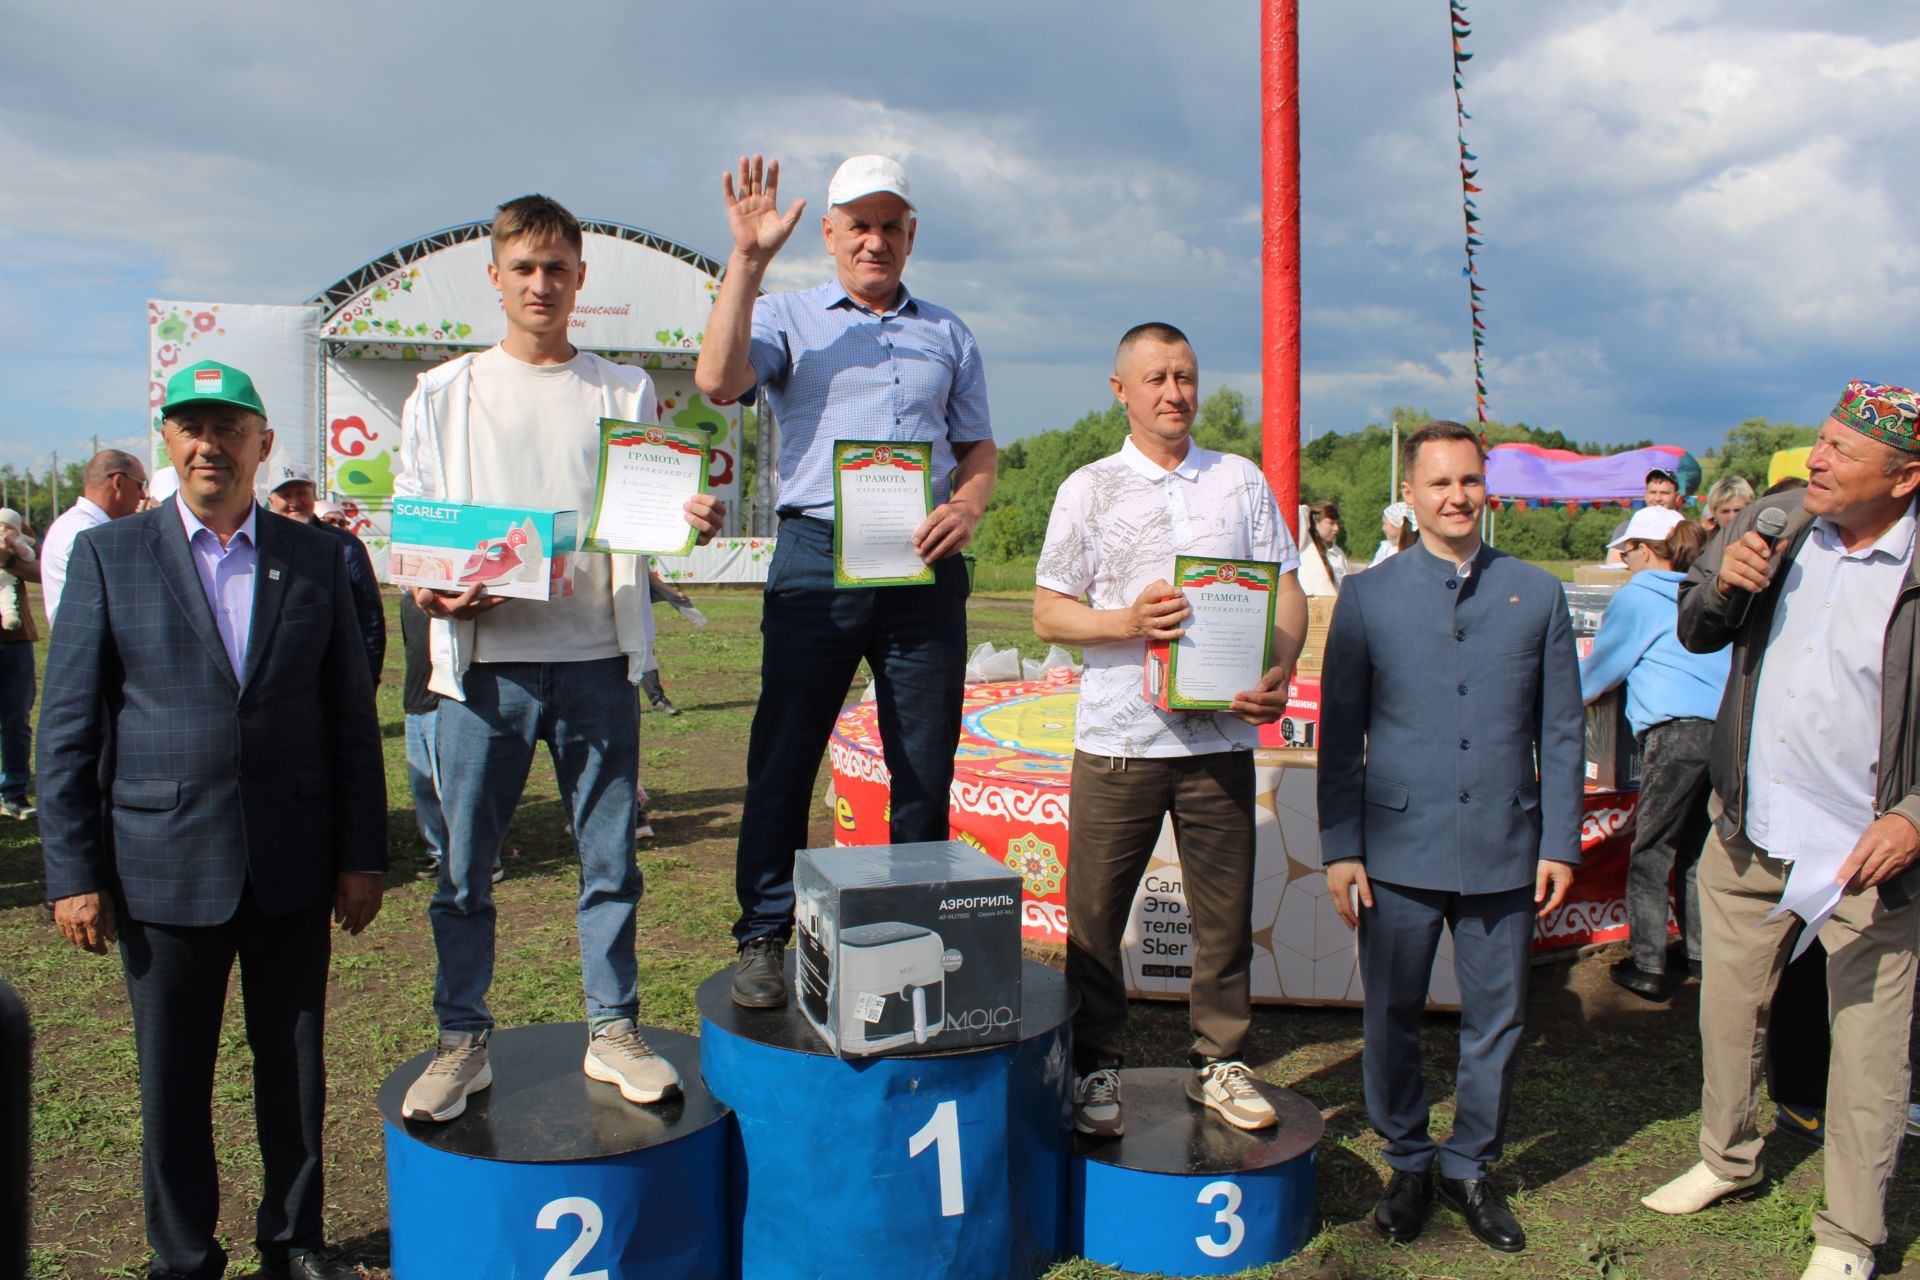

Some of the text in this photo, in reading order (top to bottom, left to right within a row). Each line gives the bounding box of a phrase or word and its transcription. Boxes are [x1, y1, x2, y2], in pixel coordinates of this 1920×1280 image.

[628, 451, 681, 465] ГРАМОТА
[283, 465, 295, 478] LA
[859, 474, 906, 483] ГРАМОТА
[396, 503, 462, 521] SCARLETT
[1200, 592, 1250, 603] ГРАМОТА
[1286, 698, 1318, 710] ашина
[1144, 876, 1182, 893] Сал
[939, 895, 1014, 911] АЭРОГРИЛЬ
[1143, 896, 1181, 914] Это
[1142, 938, 1188, 956] Sber
[946, 1006, 1014, 1036] MOJO
[908, 1100, 965, 1217] 1
[1195, 1181, 1245, 1258] 3
[535, 1196, 609, 1280] 2
